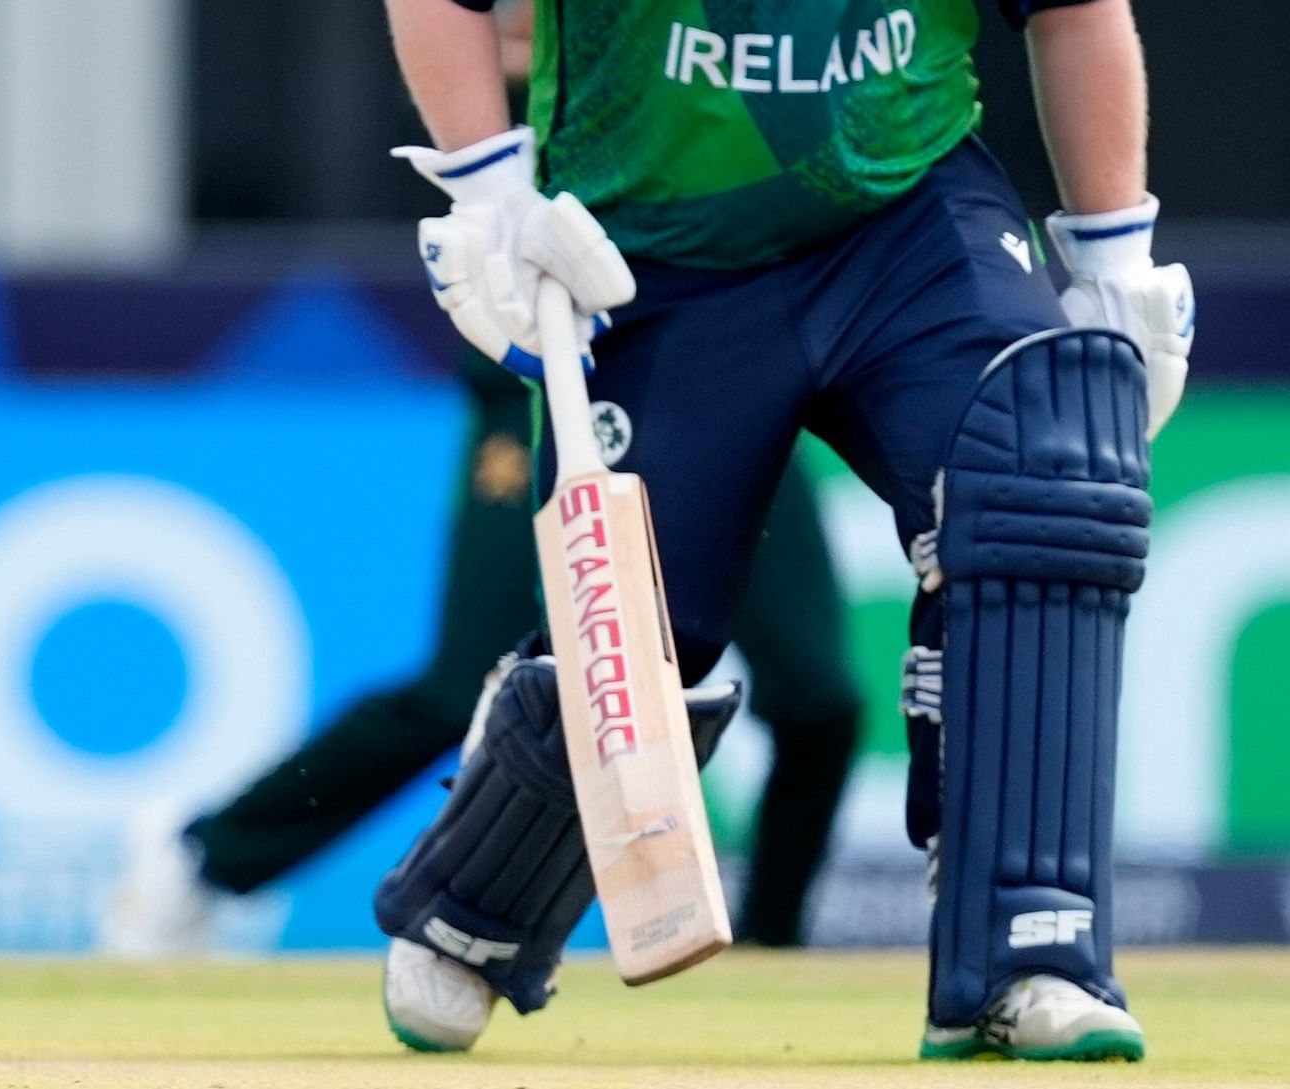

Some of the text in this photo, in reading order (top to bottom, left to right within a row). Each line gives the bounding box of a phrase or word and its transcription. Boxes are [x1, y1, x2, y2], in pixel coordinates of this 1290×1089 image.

[665, 8, 916, 94] IRELAND
[422, 916, 522, 968] SF
[1007, 909, 1094, 950] SF
